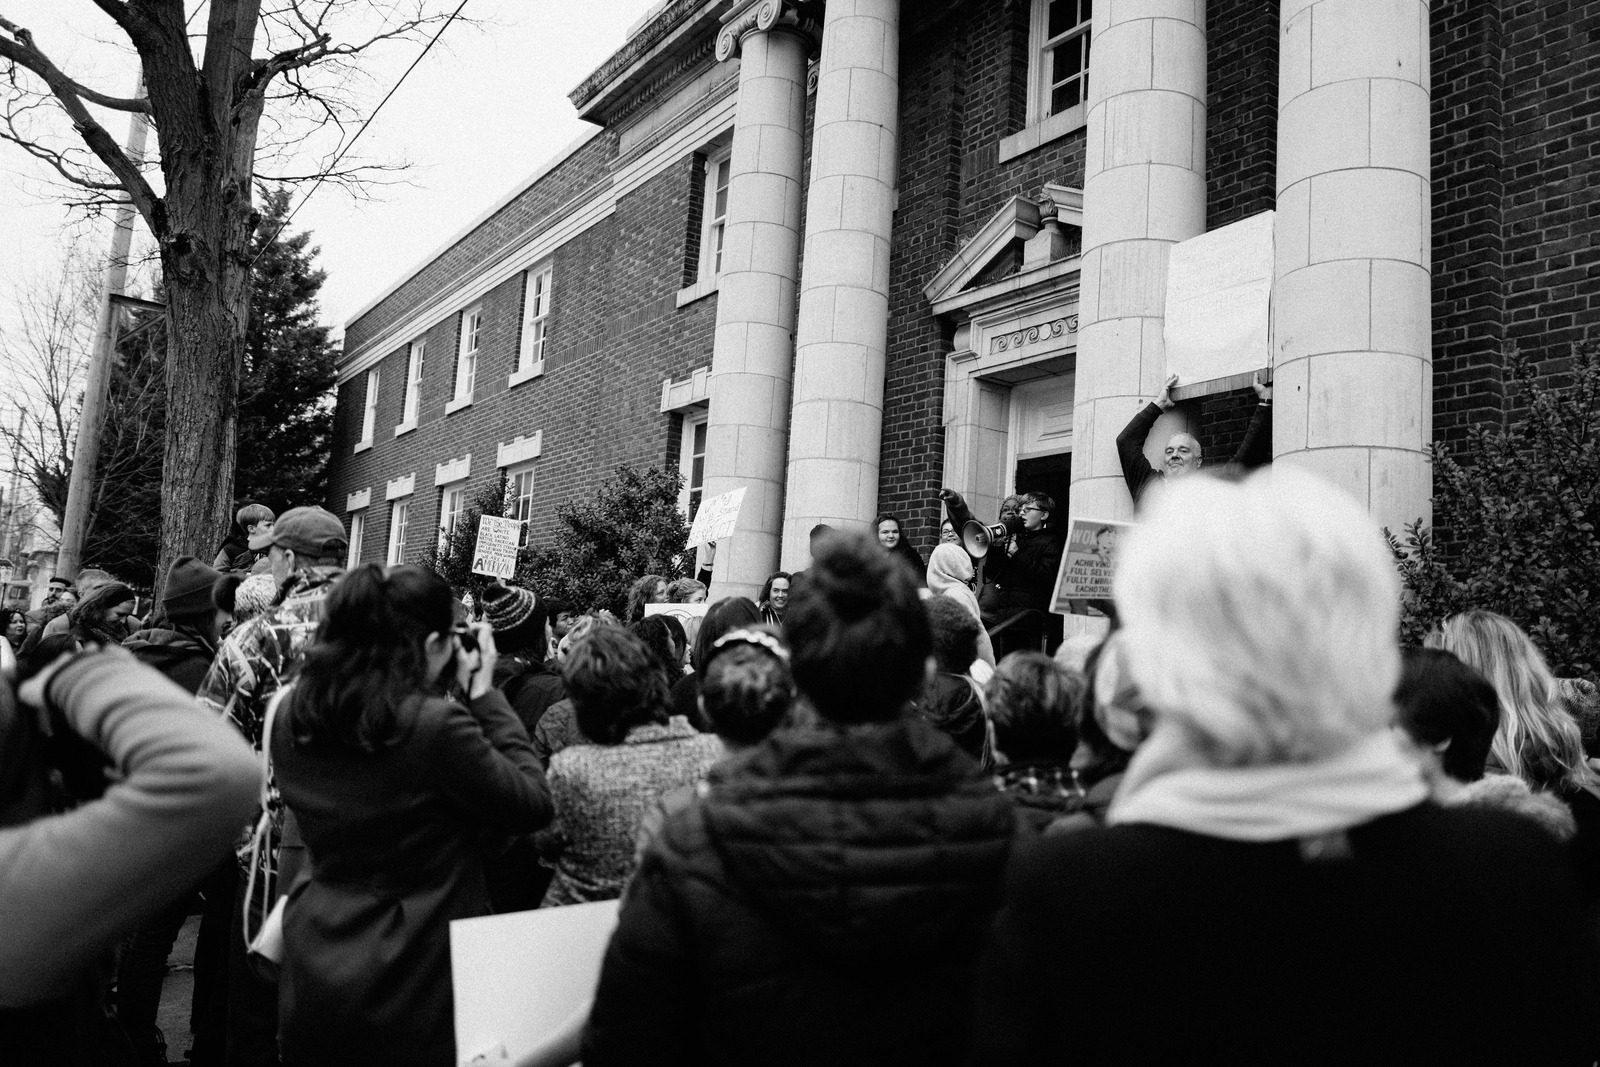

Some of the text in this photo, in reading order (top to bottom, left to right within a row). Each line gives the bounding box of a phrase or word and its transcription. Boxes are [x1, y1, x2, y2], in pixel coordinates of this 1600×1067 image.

[492, 527, 509, 535] WHITE
[494, 538, 514, 546] AMERICAN
[473, 557, 512, 575] AMERICAN
[1074, 559, 1112, 568] ACHIEVING
[1070, 567, 1088, 575] FULL
[1065, 576, 1114, 585] FULLY EMBRA
